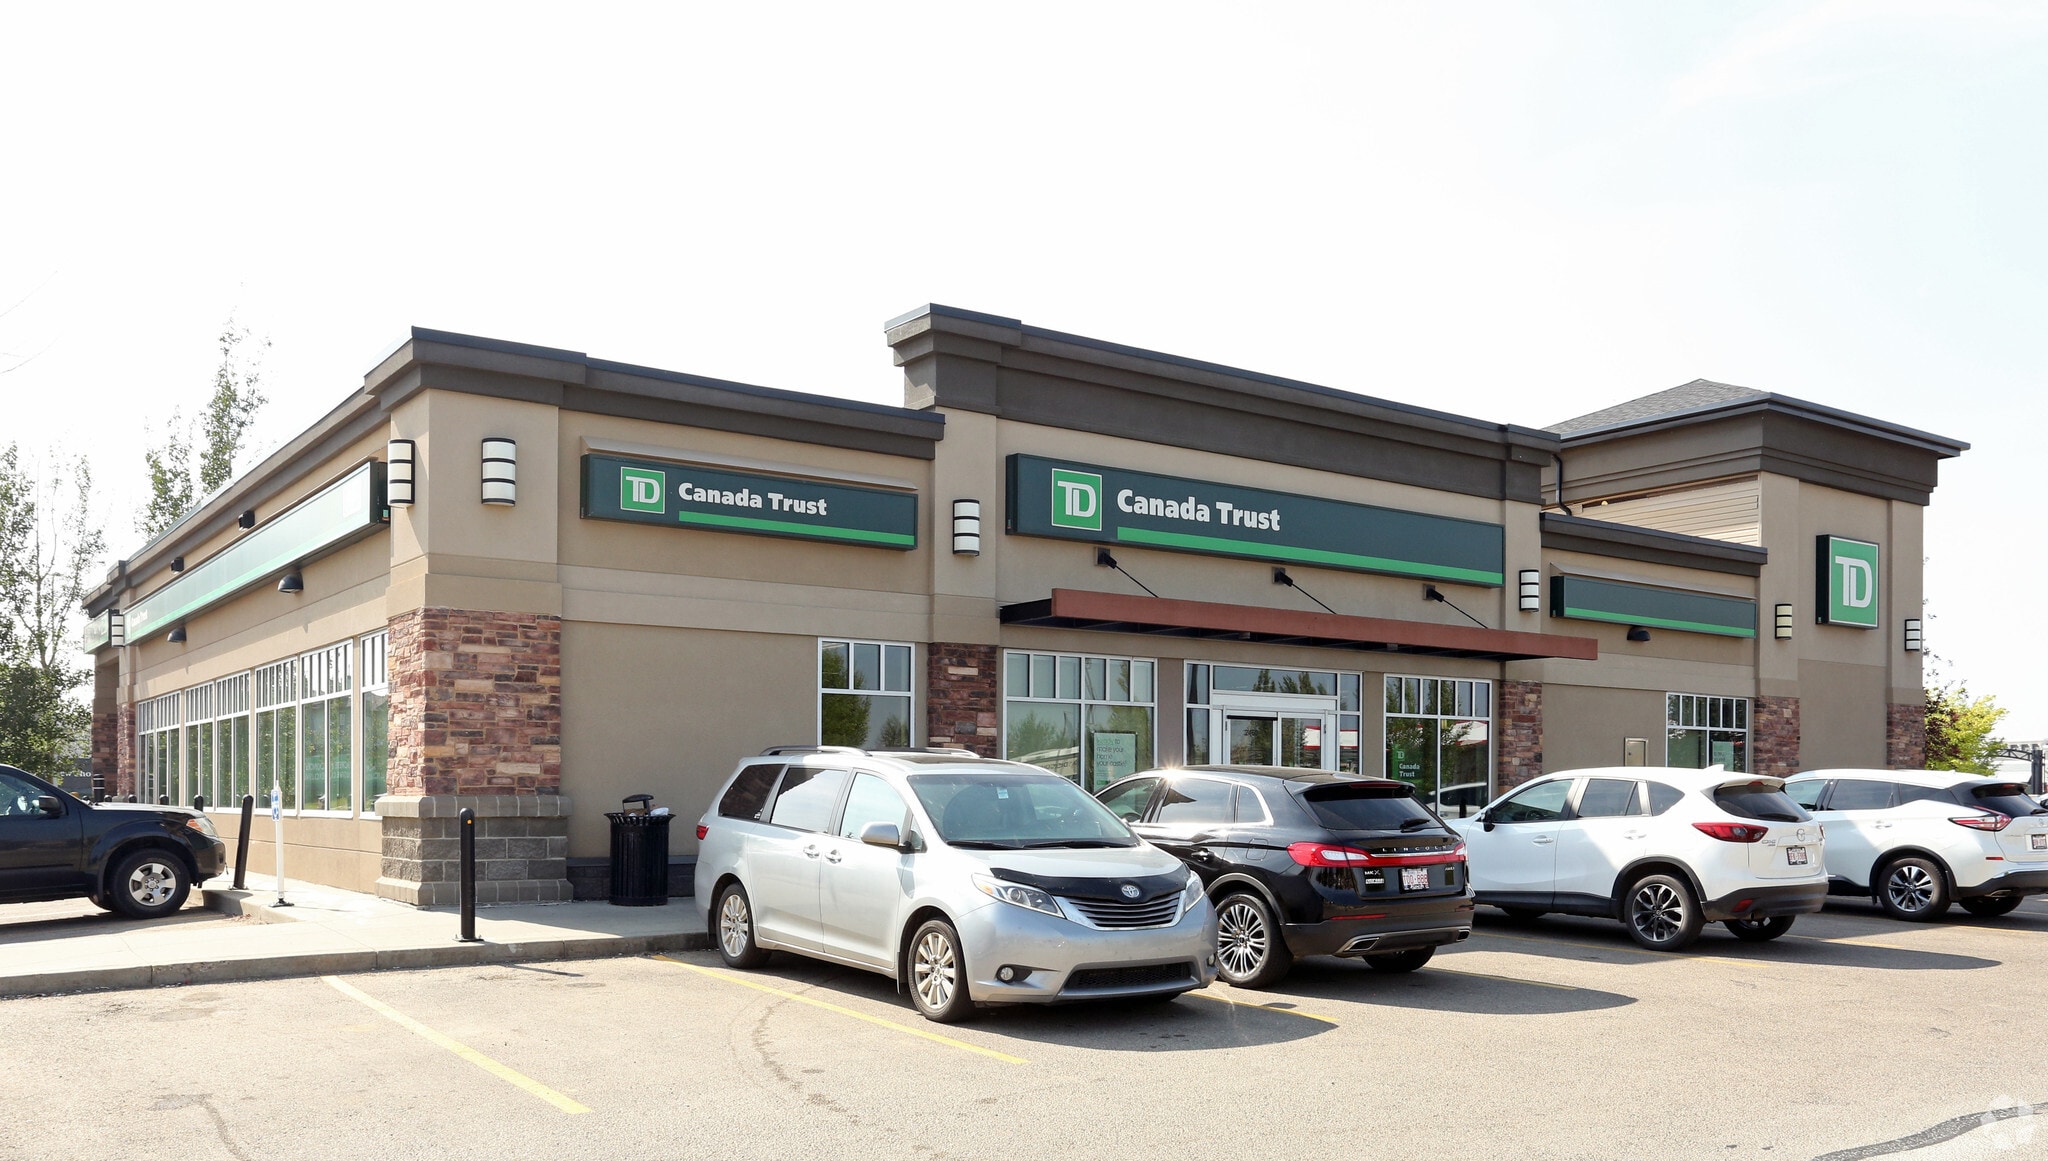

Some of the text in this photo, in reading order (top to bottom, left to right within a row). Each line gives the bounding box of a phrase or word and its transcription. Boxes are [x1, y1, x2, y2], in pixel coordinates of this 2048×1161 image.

[626, 475, 660, 503] TD
[678, 482, 827, 516] Canada Trust
[1057, 480, 1096, 518] TD
[1117, 489, 1280, 532] Canada Trust
[1835, 556, 1873, 608] TD
